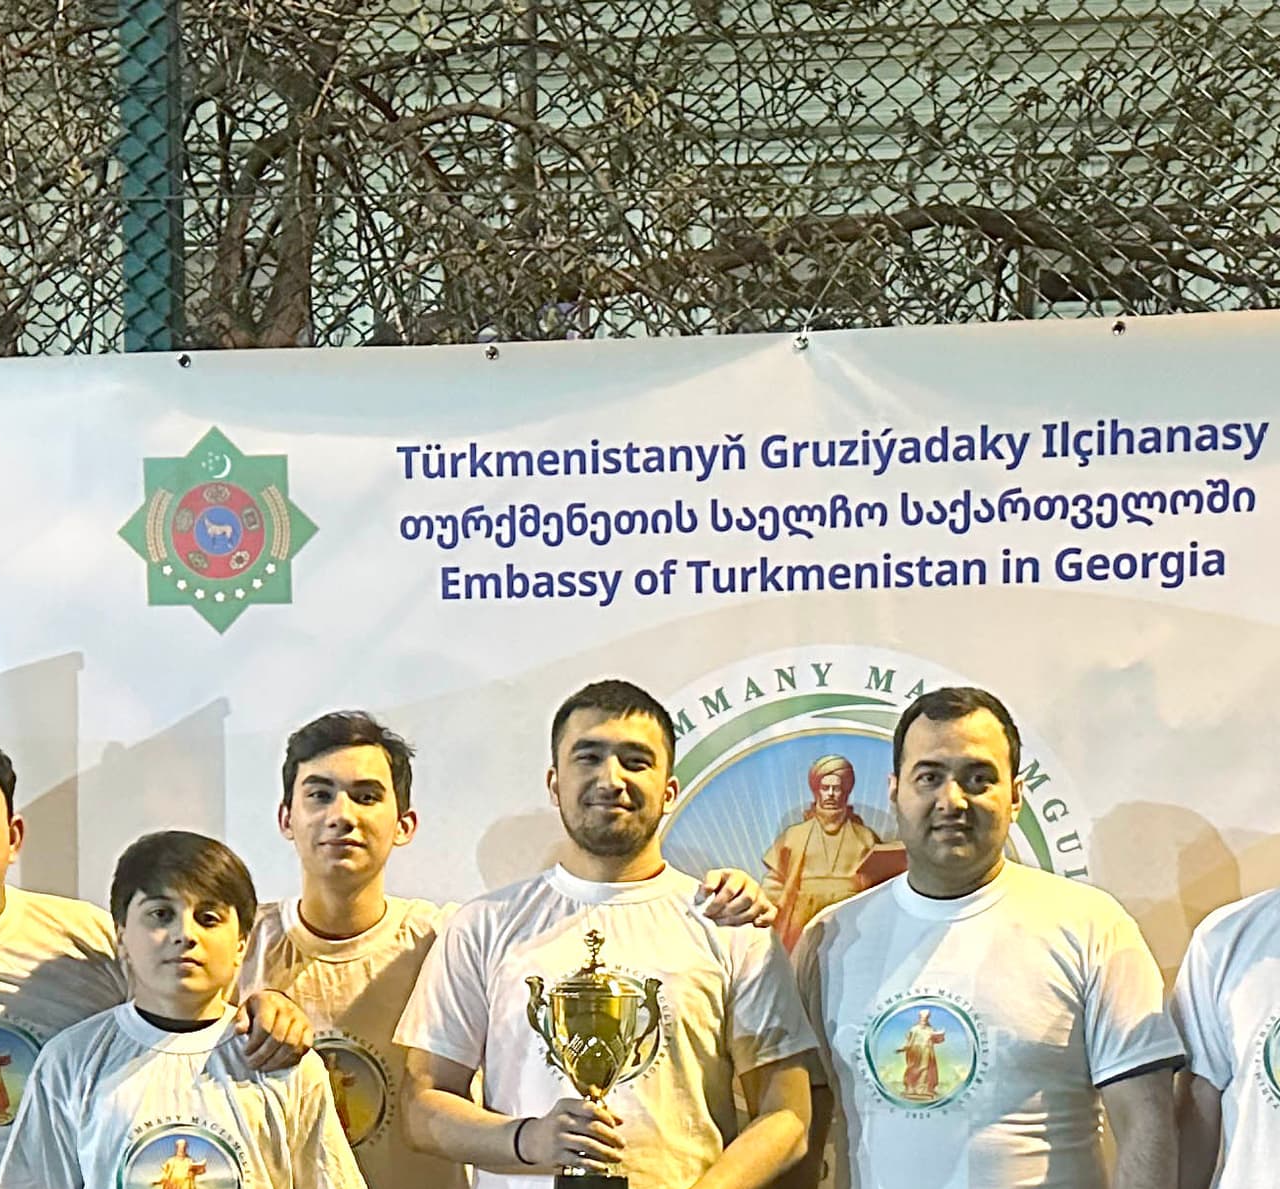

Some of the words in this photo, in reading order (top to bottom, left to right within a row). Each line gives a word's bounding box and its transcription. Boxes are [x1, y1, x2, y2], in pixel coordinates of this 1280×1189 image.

[396, 438, 746, 483] Türkmenistanyň
[760, 423, 1031, 477] Gruziýadaky
[1041, 418, 1270, 468] Ilçihanasy
[399, 499, 698, 550] თურქმენეთის
[710, 494, 888, 542] საელჩო
[900, 478, 1256, 535] საქართველოში
[441, 563, 623, 608] Embassy
[634, 558, 678, 596] of
[686, 552, 987, 594] Turkmenistan
[1002, 548, 1040, 585] in
[1054, 540, 1225, 589] Georgia
[673, 662, 833, 741] MMANY
